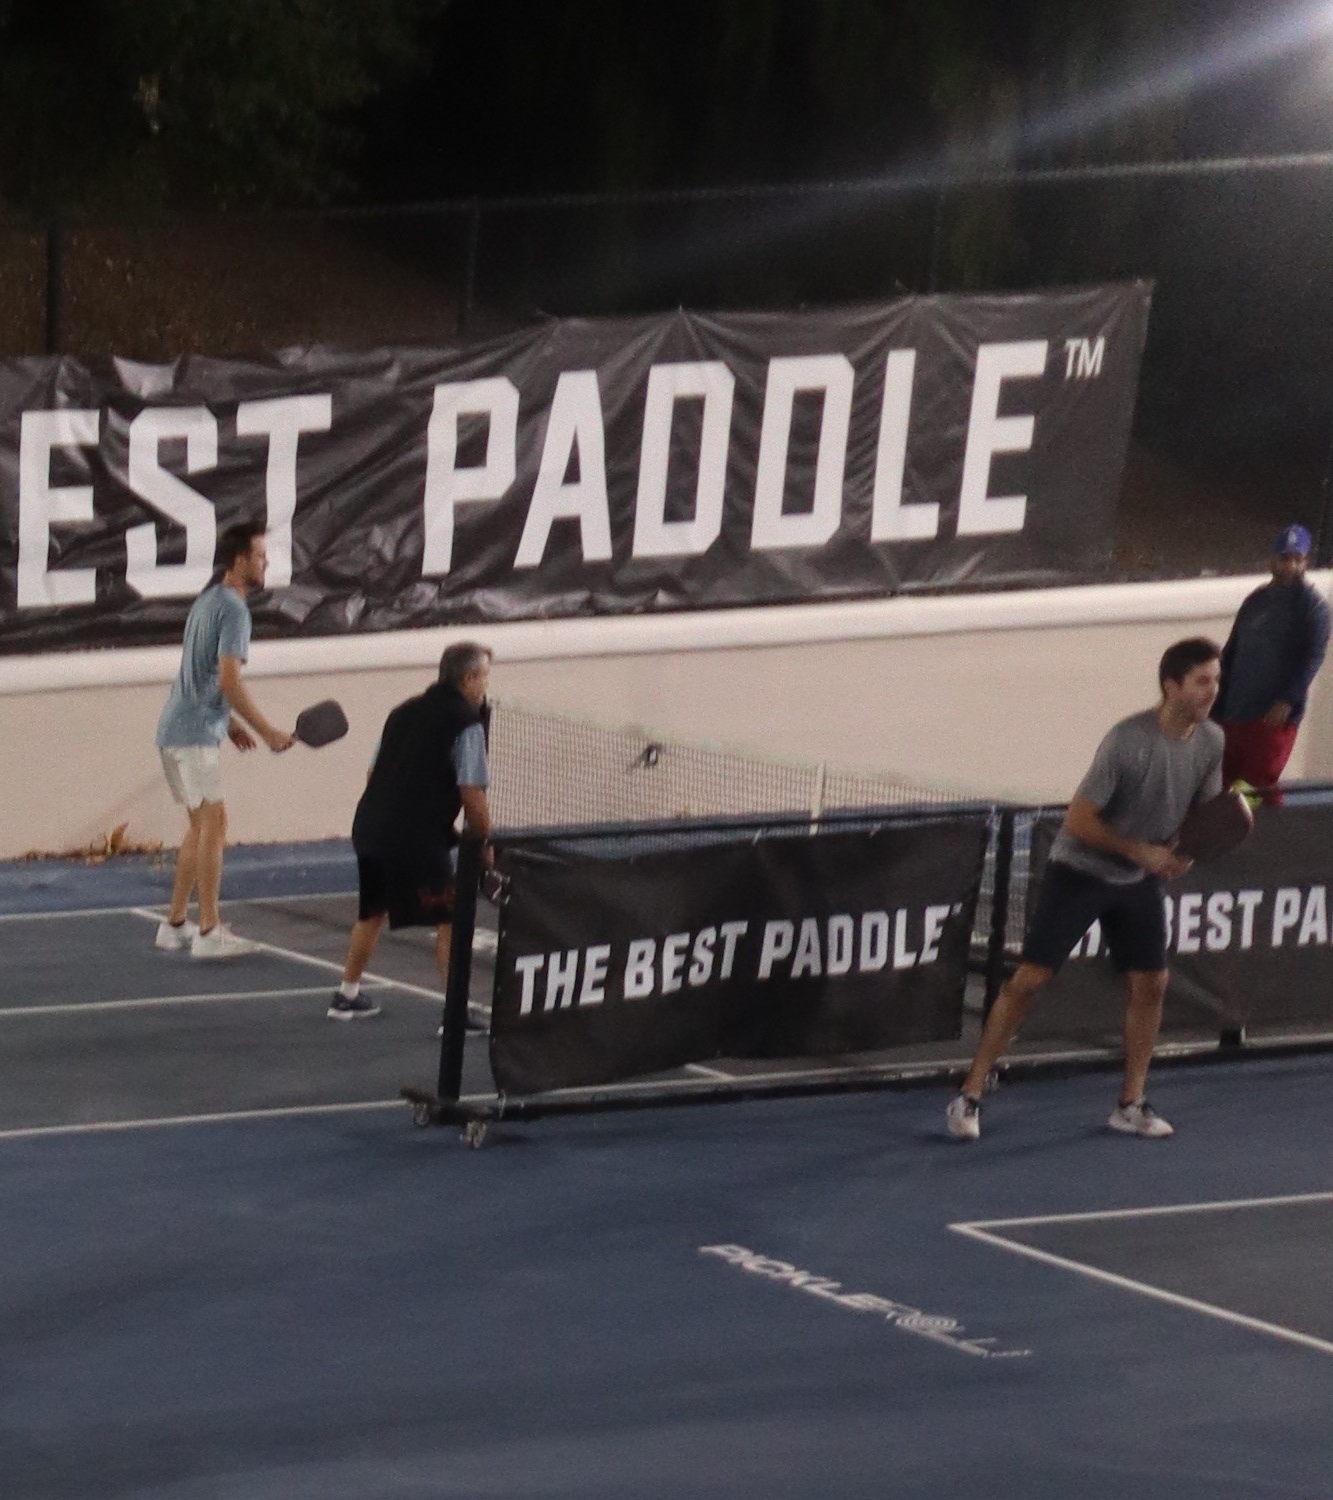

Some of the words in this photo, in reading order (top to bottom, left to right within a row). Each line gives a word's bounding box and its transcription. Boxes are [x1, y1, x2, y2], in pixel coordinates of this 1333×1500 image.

[1270, 884, 1333, 949] PA
[514, 944, 611, 1016] THE
[622, 919, 749, 1001] BEST
